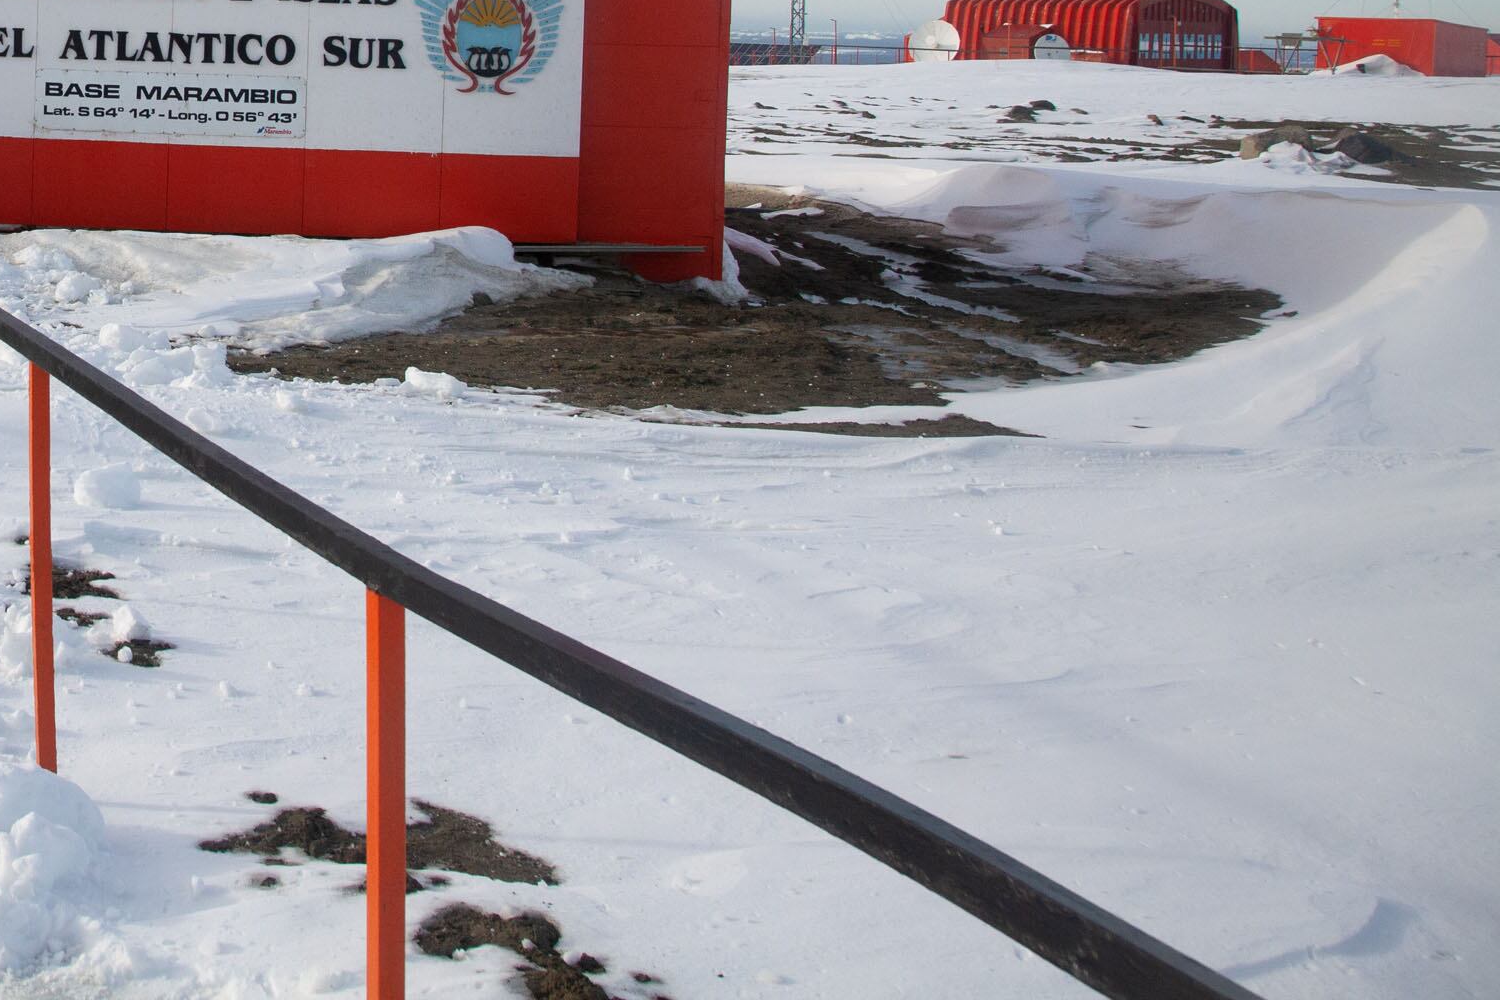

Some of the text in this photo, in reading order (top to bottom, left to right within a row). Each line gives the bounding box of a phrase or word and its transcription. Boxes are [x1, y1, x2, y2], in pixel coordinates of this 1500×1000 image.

[58, 29, 297, 67] ATLANTICO
[322, 35, 408, 71] SUR
[44, 81, 298, 105] BASE MARAMBIO
[43, 104, 75, 117] Lat.
[77, 106, 91, 118] S
[93, 106, 125, 119] 64°
[128, 108, 156, 119] 14'
[167, 109, 213, 124] Long.
[232, 111, 265, 123] 56°
[267, 112, 297, 124] 43'
